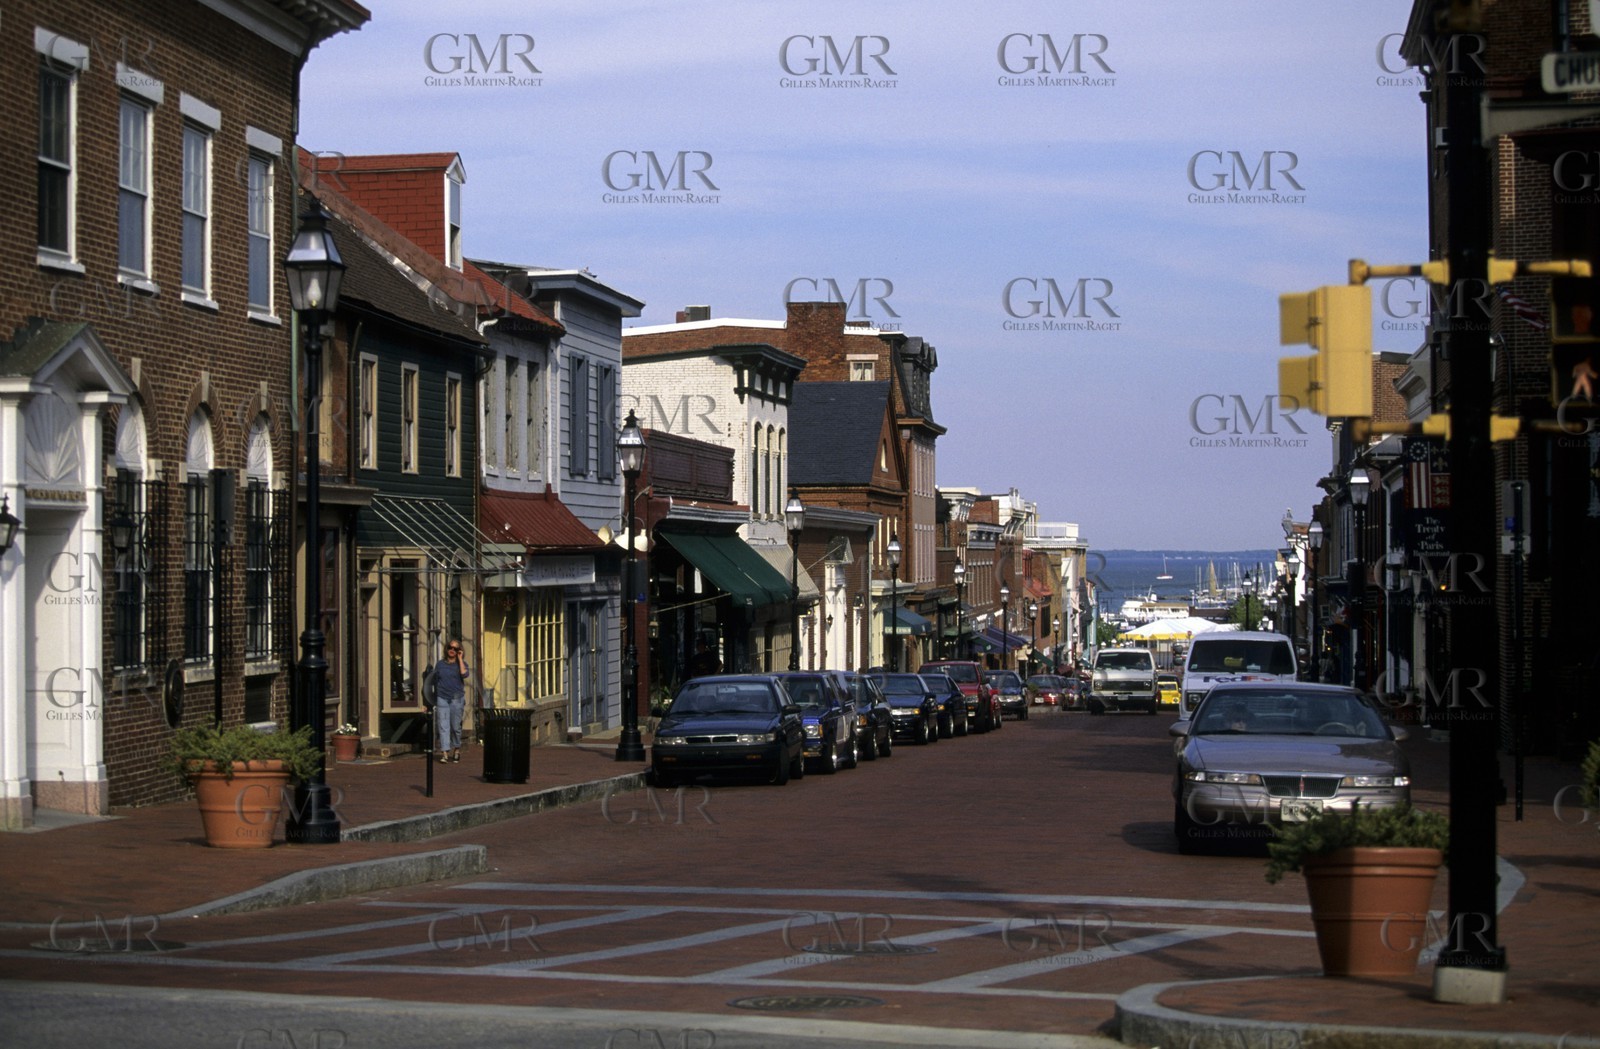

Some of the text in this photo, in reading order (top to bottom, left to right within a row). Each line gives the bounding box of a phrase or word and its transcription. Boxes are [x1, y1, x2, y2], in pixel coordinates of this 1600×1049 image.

[1555, 57, 1600, 87] CHU
[1424, 516, 1438, 525] The
[1415, 524, 1446, 534] Treaty
[1418, 541, 1444, 550] Paris
